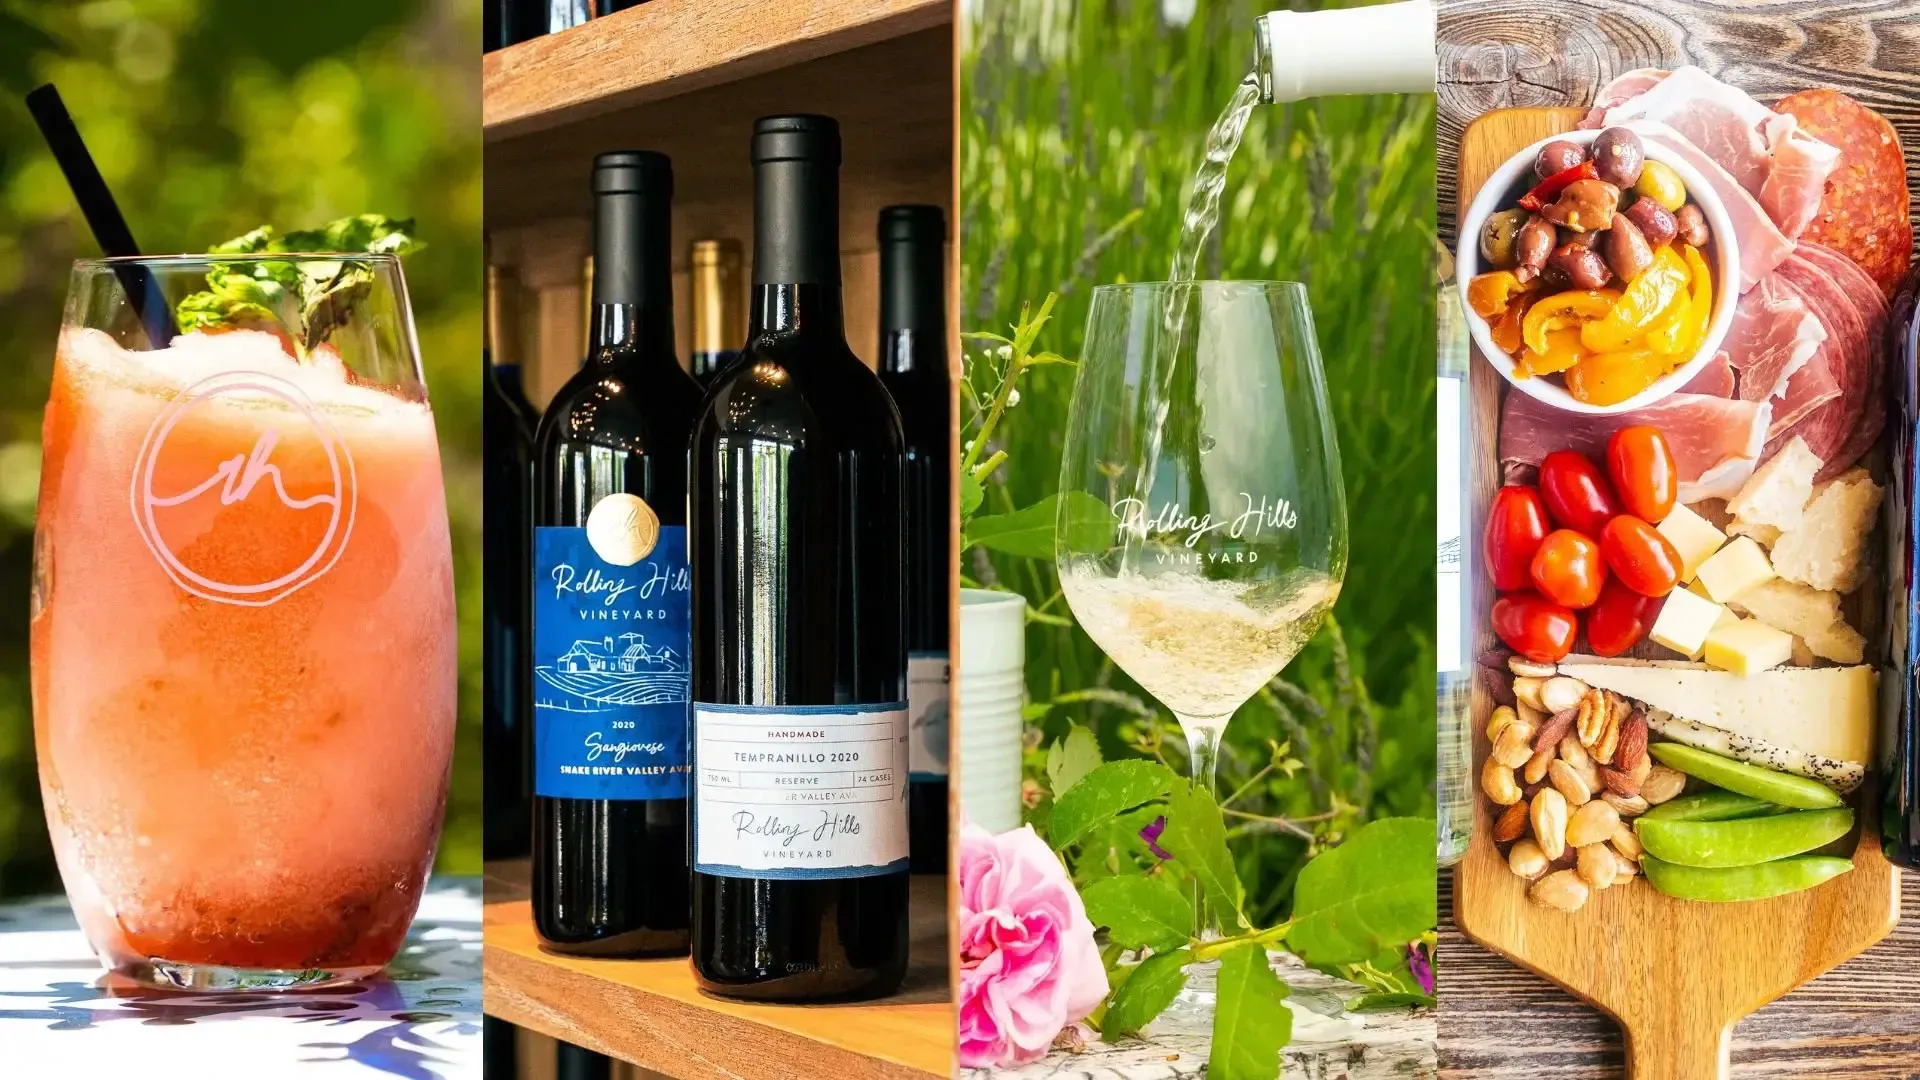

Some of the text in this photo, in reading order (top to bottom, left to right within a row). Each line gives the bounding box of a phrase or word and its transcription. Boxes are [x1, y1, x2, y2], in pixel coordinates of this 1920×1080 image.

[1111, 492, 1298, 548] Rolling Hills
[1156, 551, 1259, 565] VINEYARD
[551, 562, 691, 606] Rolling Hill
[579, 609, 667, 620] VINEYARD
[612, 720, 635, 729] 2020
[767, 730, 825, 739] HANDMADE
[584, 731, 666, 762] Sangiovese
[734, 751, 859, 763] TEMPRANILLO 2020
[560, 765, 590, 775] SNAKE
[592, 765, 623, 775] RIVER
[627, 765, 667, 775] VALLEY
[720, 775, 732, 783] ML
[774, 776, 819, 785] RESERVE
[857, 773, 891, 783] 74 CASES
[801, 792, 837, 801] VALLEY
[732, 809, 860, 847] Rolling Hills
[763, 849, 832, 859] VINEYARD
